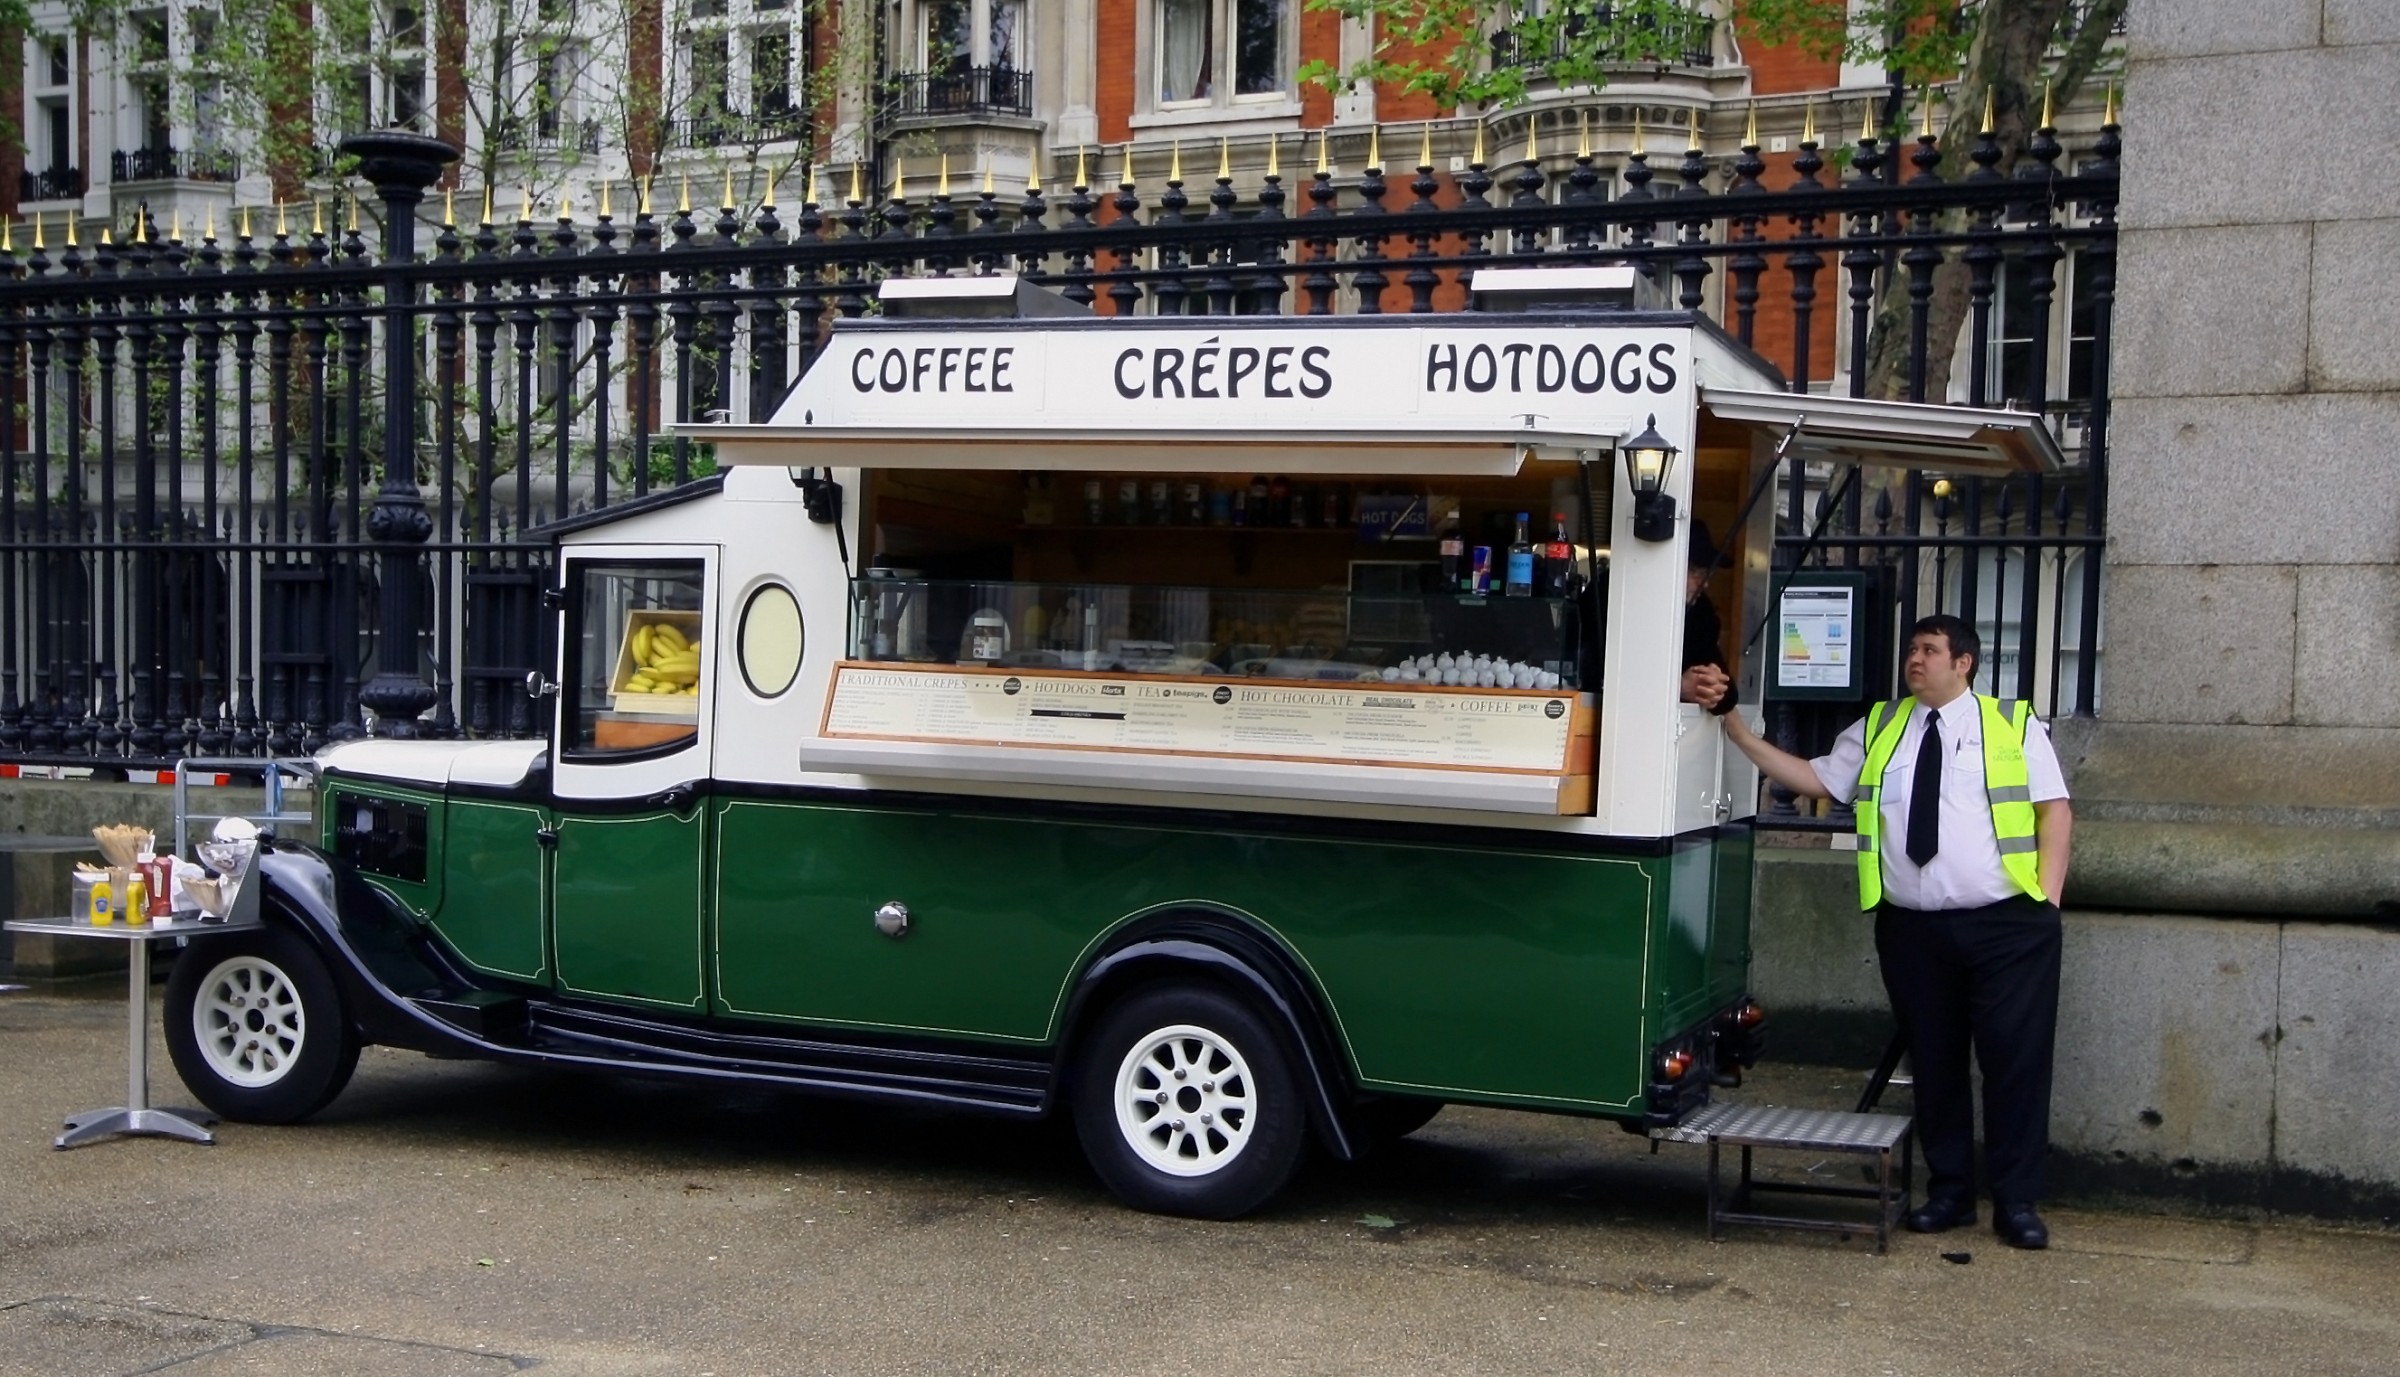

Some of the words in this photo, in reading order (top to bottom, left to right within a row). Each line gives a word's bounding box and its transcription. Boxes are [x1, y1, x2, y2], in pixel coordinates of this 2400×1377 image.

[852, 347, 1015, 393] COFFEE
[1113, 335, 1333, 400] CRÉPES
[1427, 343, 1677, 394] HOTDOGS
[1361, 511, 1388, 524] HOT
[840, 673, 922, 688] TRADITIONAL
[923, 677, 968, 690] CREPES
[1033, 681, 1096, 695] HOTDOGS
[1137, 685, 1160, 698] TEA
[1240, 690, 1270, 703] HOT
[1273, 692, 1355, 707] CHOCOLATE
[1460, 700, 1513, 713] COFFEE
